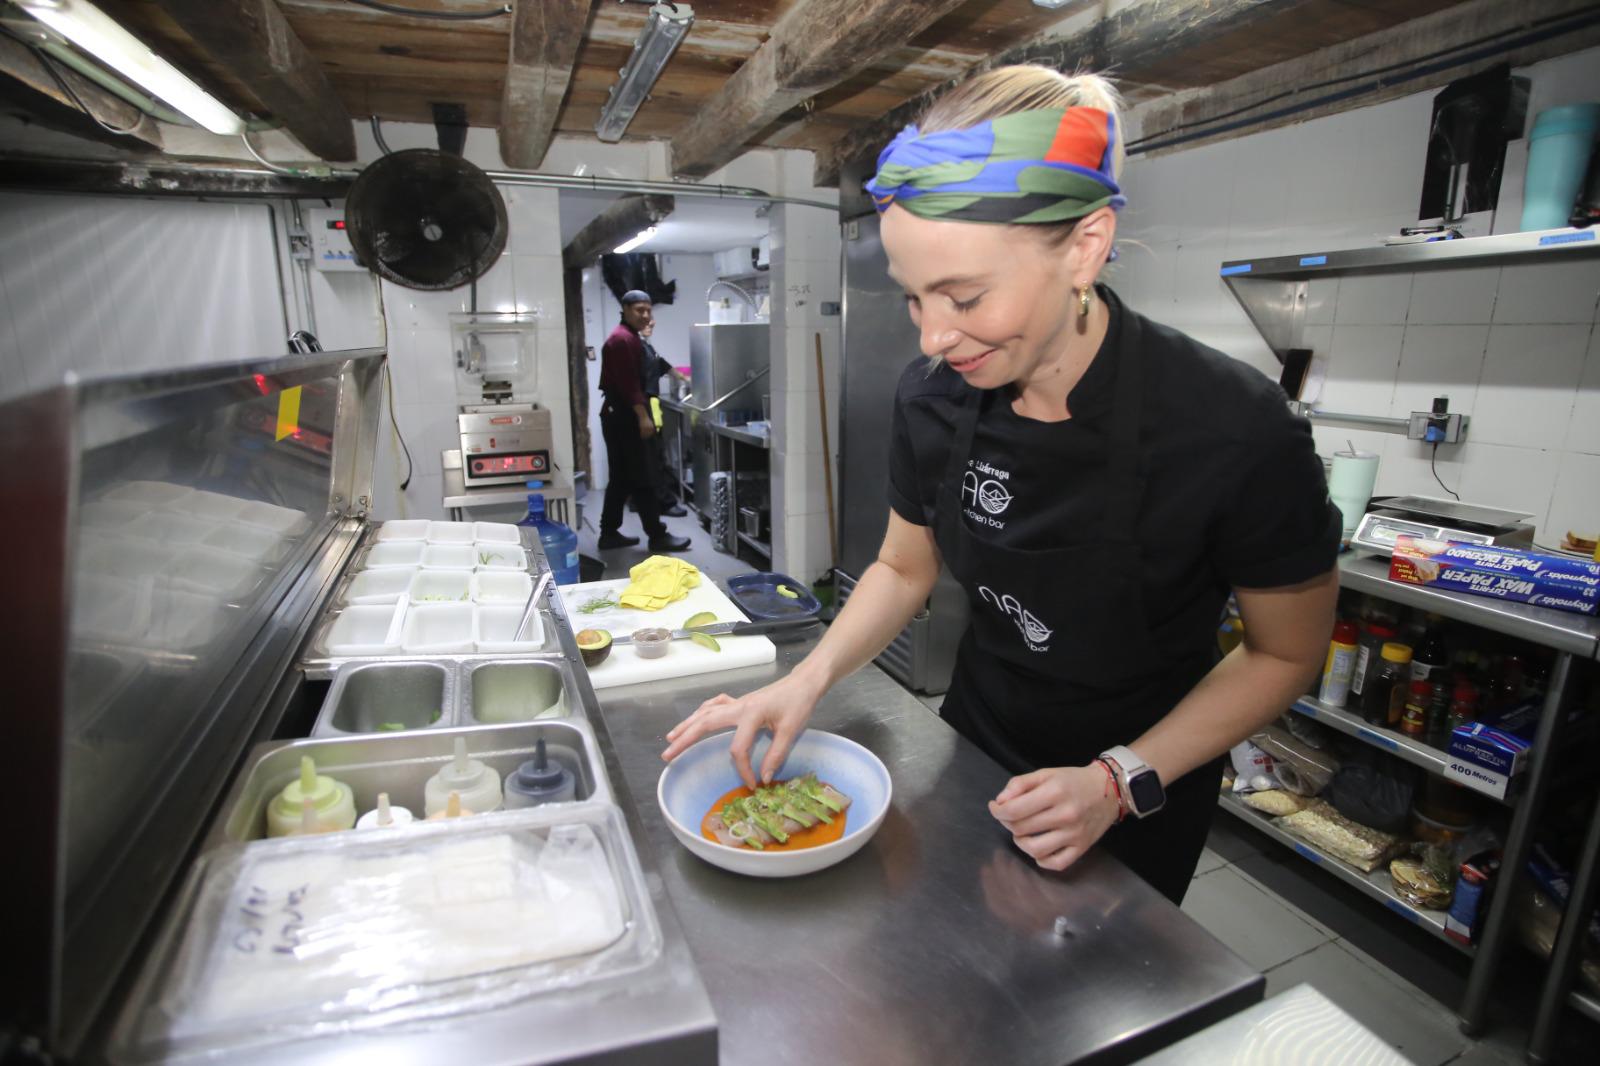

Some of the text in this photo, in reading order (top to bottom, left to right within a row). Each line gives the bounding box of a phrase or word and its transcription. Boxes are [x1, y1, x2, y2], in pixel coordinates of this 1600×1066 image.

[988, 516, 1006, 530] bar
[1446, 548, 1502, 564] ENCERADO
[1502, 555, 1543, 572] PAPEL
[1441, 569, 1495, 586] PAPER
[1547, 571, 1600, 586] Reynolds
[1468, 584, 1508, 596] CUT-RITE
[1494, 577, 1535, 595] WAX
[1582, 587, 1597, 597] 33
[1541, 596, 1594, 612] Reynolds
[1029, 642, 1050, 652] bar
[1450, 763, 1497, 786] 400 Metros
